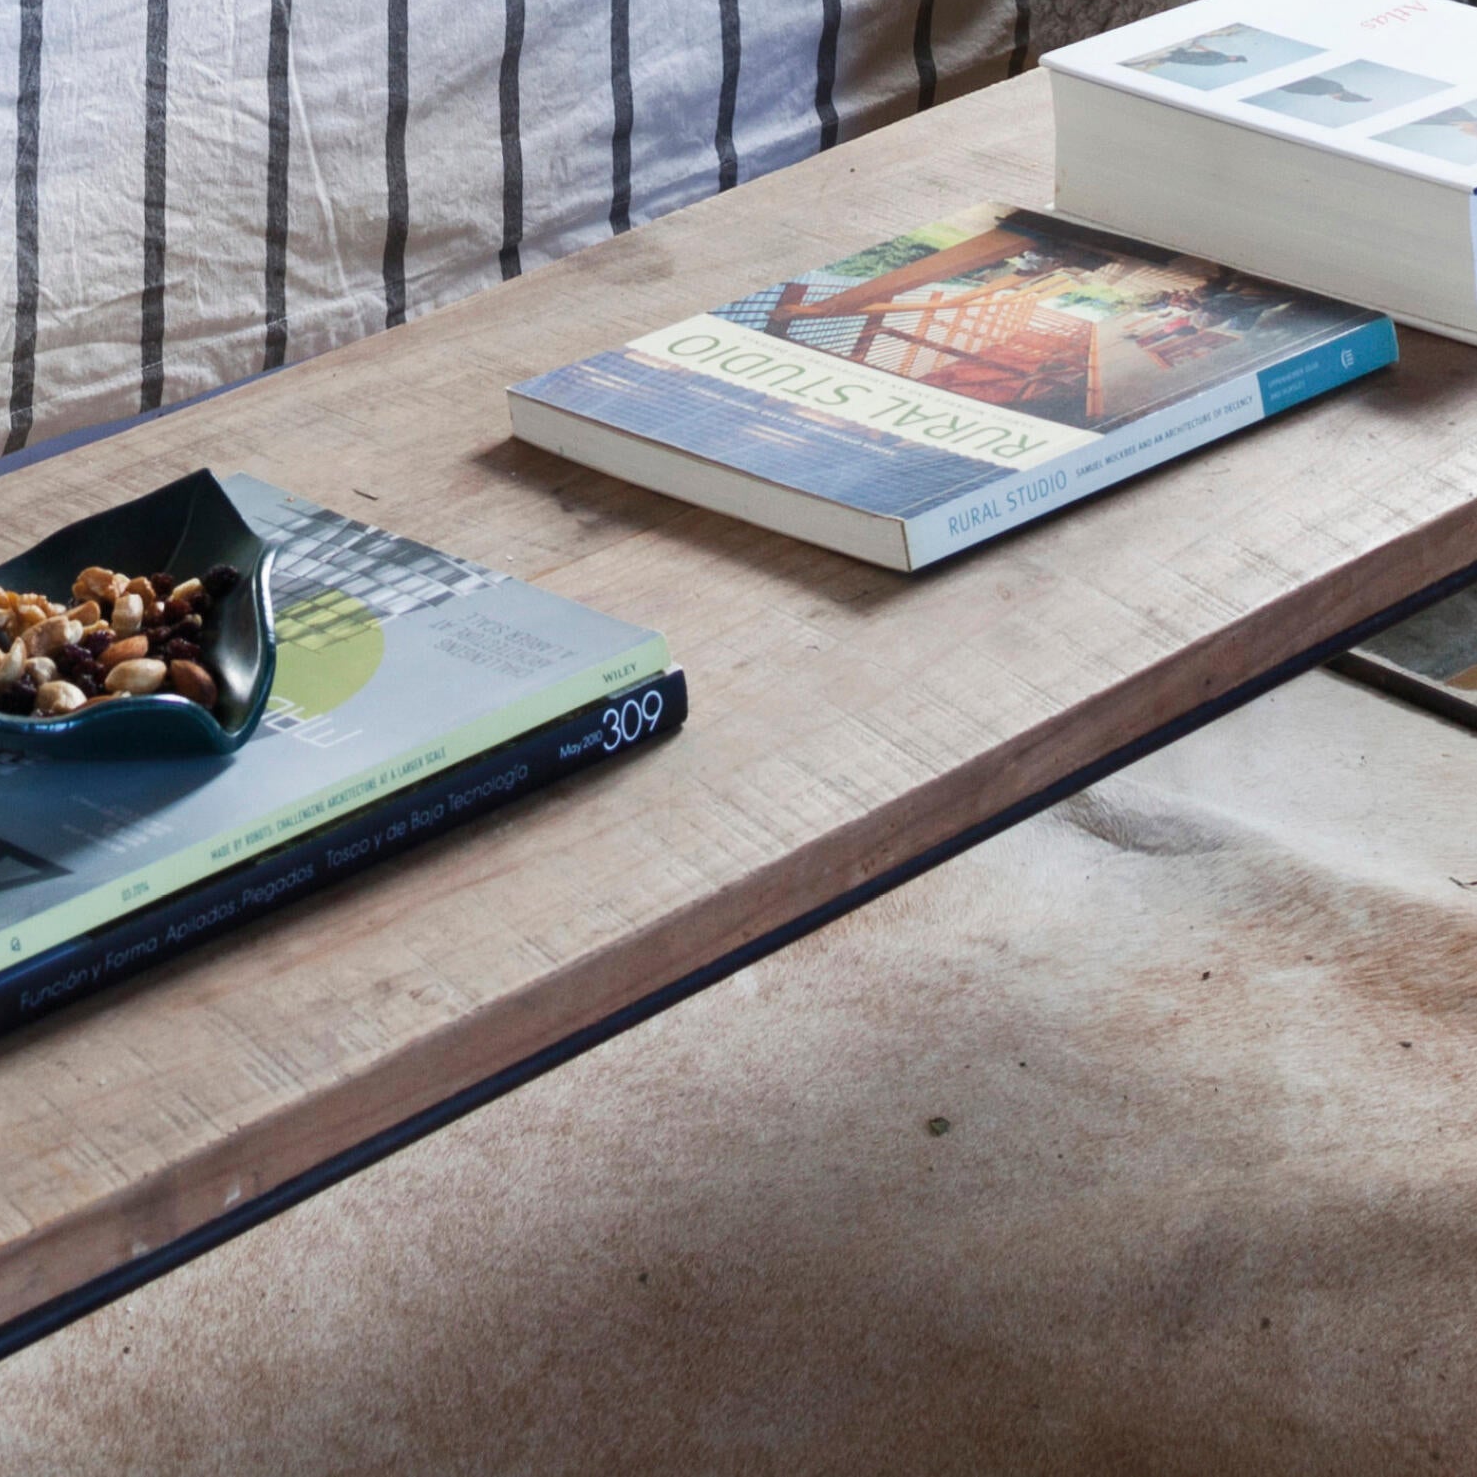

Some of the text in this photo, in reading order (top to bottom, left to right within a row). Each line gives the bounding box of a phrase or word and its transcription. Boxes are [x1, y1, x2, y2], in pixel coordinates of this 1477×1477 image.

[1360, 0, 1428, 29] Atlas
[667, 334, 874, 407] STUDIO
[868, 395, 1049, 459] RURAL
[947, 395, 1253, 537] RURAL STUDIO SAMUEL MOCKBEE AND AN ARCHITECTURE OF DECENCY
[276, 802, 324, 832] CHALLENGING
[326, 780, 378, 811] ARCHITECTURE
[380, 770, 389, 784] AT
[391, 768, 397, 779] A
[398, 756, 424, 777] LARGER
[425, 746, 447, 766] SCALE
[602, 661, 637, 684] WILEY
[20, 966, 89, 1011] Función
[89, 962, 100, 980] y
[105, 934, 159, 972] Forma
[326, 836, 370, 869] Tosco
[373, 833, 382, 852] y
[385, 818, 406, 841] de
[410, 803, 445, 831] Baja
[446, 762, 529, 812] Tecnología
[559, 740, 582, 759] May
[582, 729, 603, 750] 2010
[603, 689, 664, 751] 309
